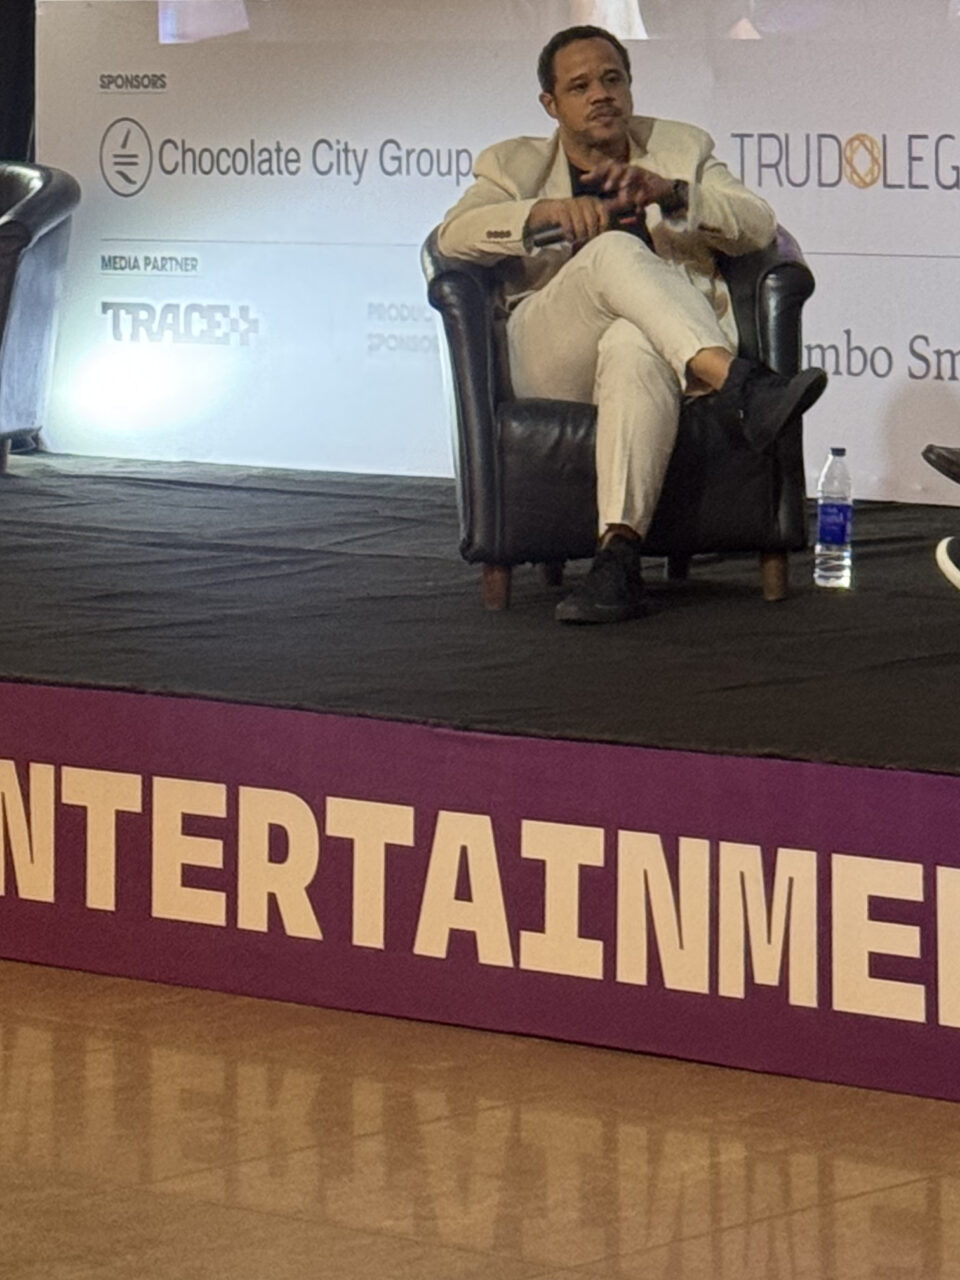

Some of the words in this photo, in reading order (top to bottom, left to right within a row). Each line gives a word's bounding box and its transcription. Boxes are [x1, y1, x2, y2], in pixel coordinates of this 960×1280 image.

[100, 74, 167, 89] SPONSORS
[158, 138, 301, 176] Chocolate
[311, 139, 368, 186] City
[379, 138, 473, 186] Group
[101, 255, 141, 271] MEDIA
[144, 256, 199, 272] PARTNER
